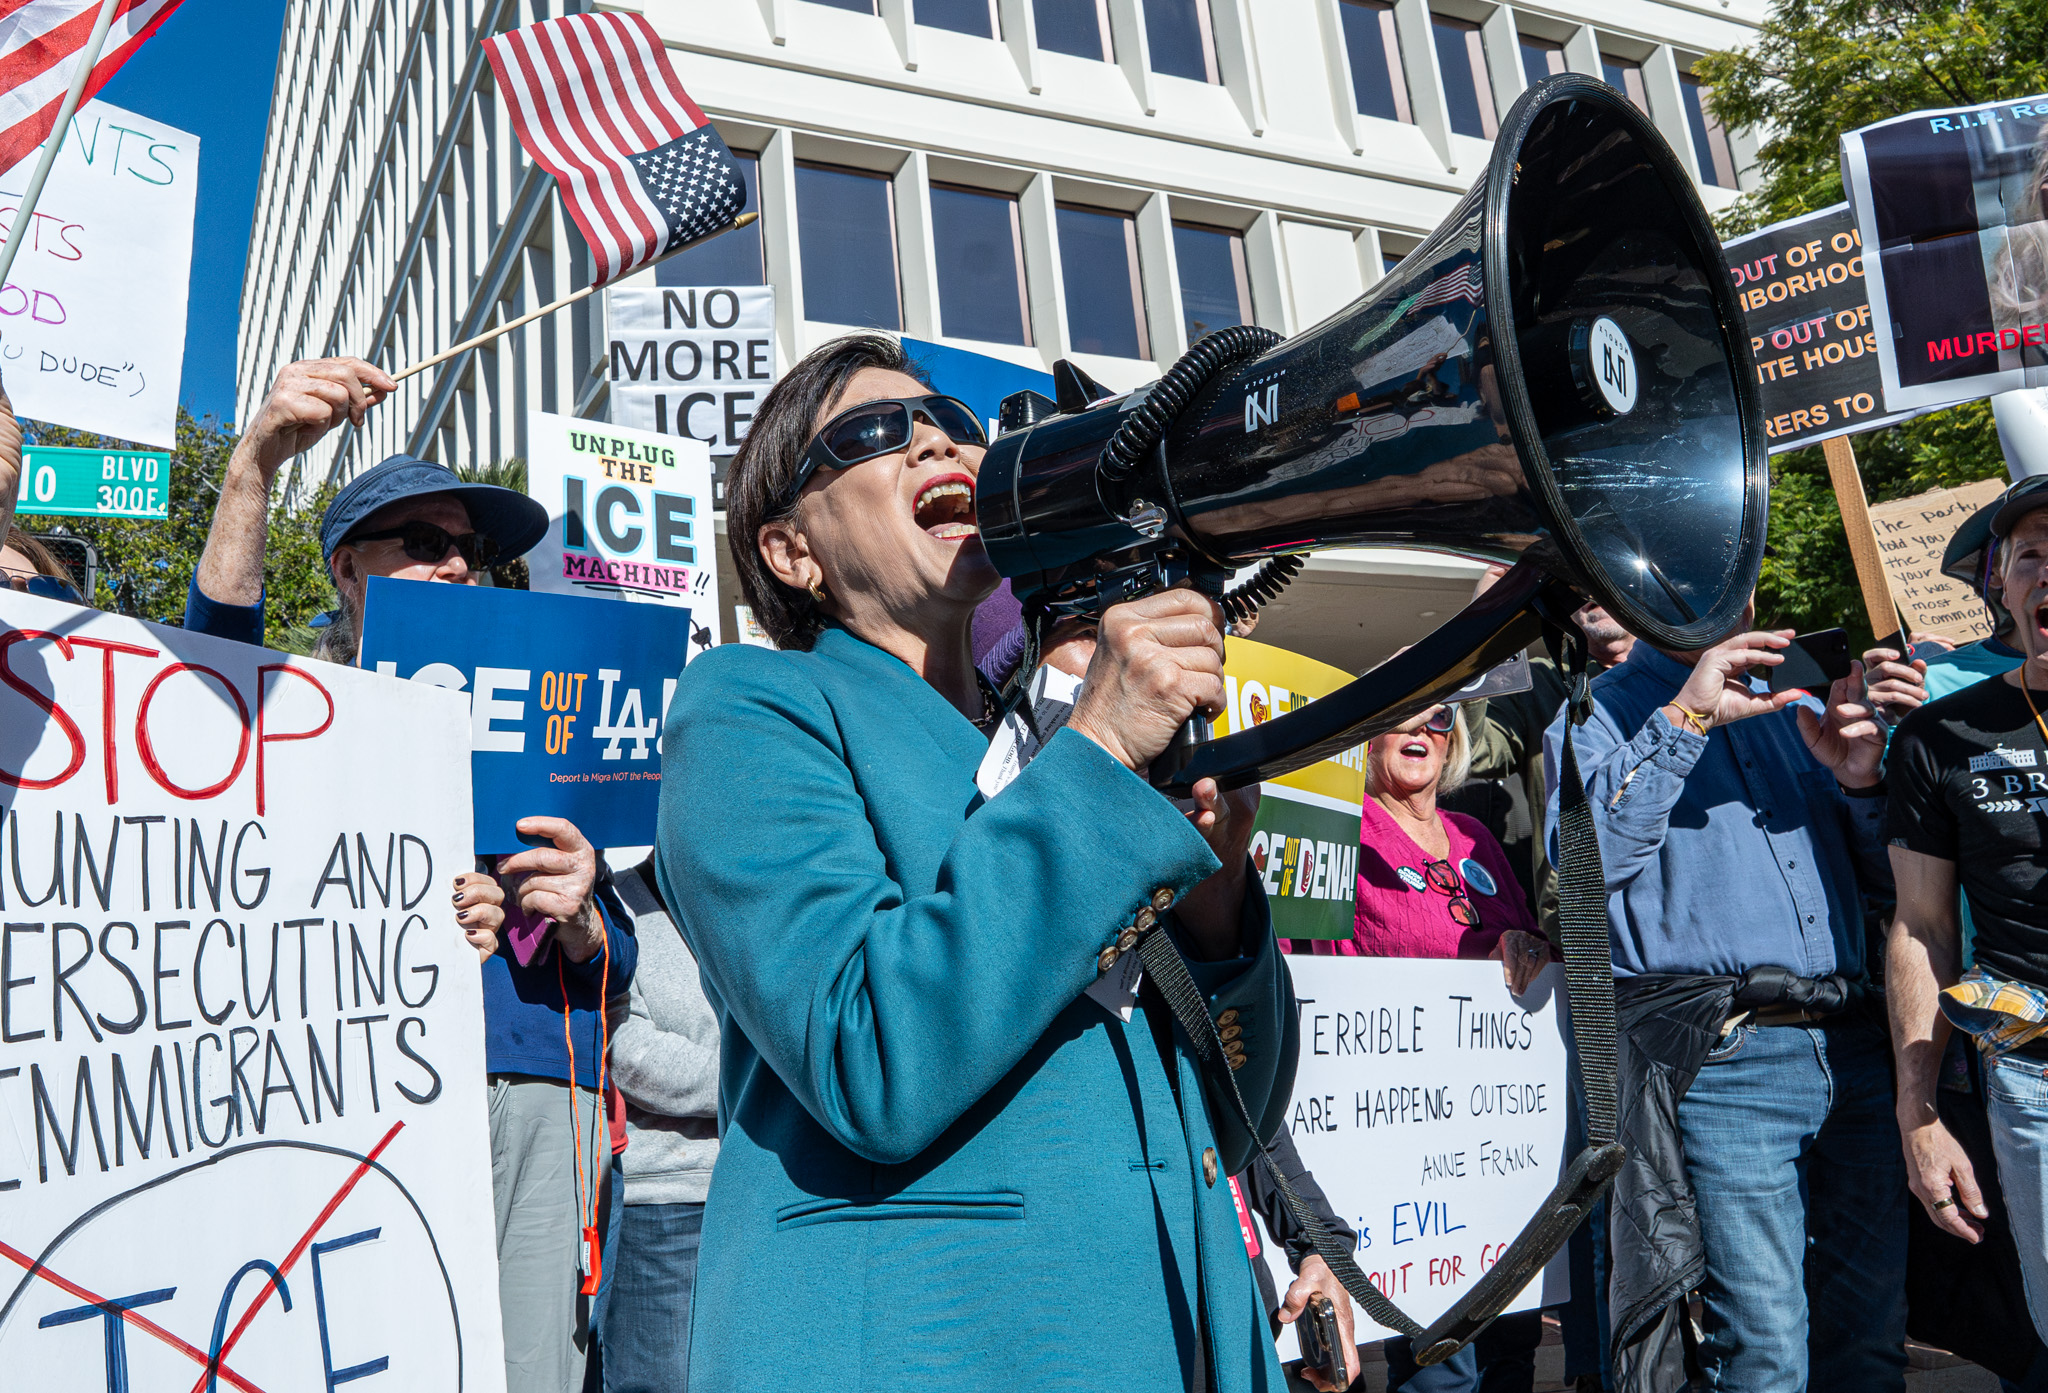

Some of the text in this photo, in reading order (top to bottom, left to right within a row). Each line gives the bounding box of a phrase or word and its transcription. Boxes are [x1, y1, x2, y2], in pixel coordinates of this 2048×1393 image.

[1929, 110, 2004, 134] R.I.P.
[1786, 239, 1823, 268] OF
[663, 288, 740, 330] NO
[1771, 317, 1827, 350] OUT
[1926, 321, 2048, 363] MURDE
[611, 339, 770, 382] MORE
[1833, 392, 1875, 419] TO
[571, 431, 675, 468] UNPLUG
[102, 455, 159, 482] BLVD
[601, 458, 653, 484] THE
[564, 475, 697, 564] ICE
[1872, 501, 1978, 537] The party
[1878, 538, 1908, 552] told
[1885, 555, 1920, 569] the
[565, 556, 686, 590] MACHINE
[1912, 598, 1952, 611] most
[540, 670, 588, 713] OUT
[0, 629, 335, 817] STOP
[545, 714, 576, 755] OF
[549, 772, 580, 784] Deport
[591, 773, 611, 783] Migra
[612, 772, 629, 781] NOT
[629, 771, 641, 781] the
[1971, 777, 1990, 800] 3
[311, 832, 433, 912] AND
[1281, 867, 1294, 896] OF
[1283, 836, 1300, 866] OUT
[1294, 837, 1358, 902] DENA!
[2, 914, 440, 1043] ERSECUTING
[1296, 995, 1534, 1056] TERRIBLE THINGS
[1292, 1095, 1338, 1136] ARE
[1470, 1083, 1548, 1118] OUTSIDE
[1421, 1140, 1538, 1186] ANNE FRANK
[1358, 1200, 1467, 1252] is EVIL
[1429, 1255, 1466, 1287] FOR
